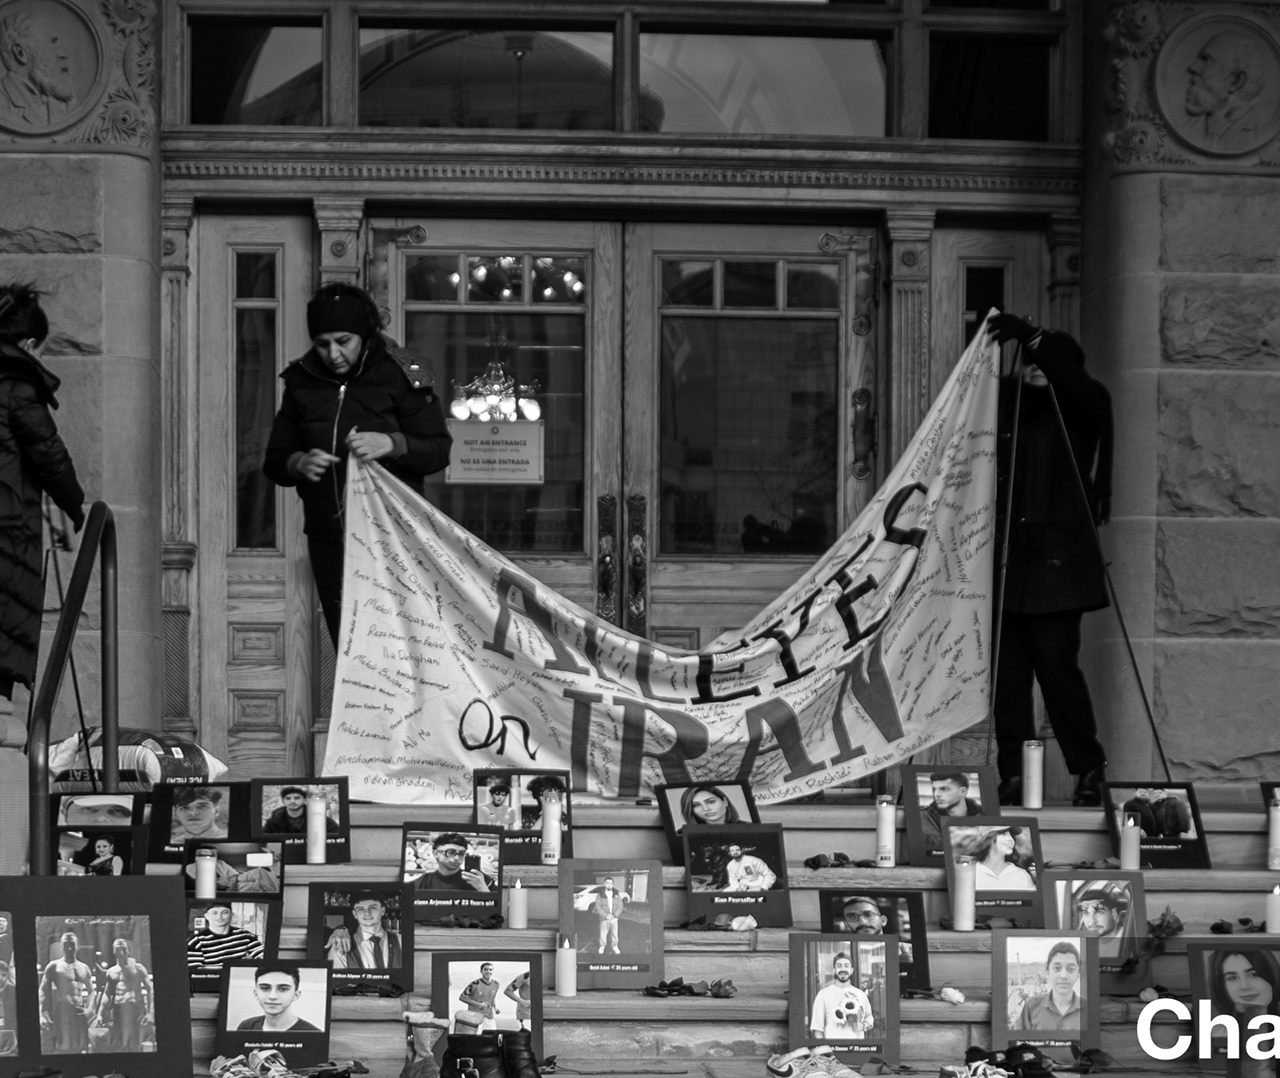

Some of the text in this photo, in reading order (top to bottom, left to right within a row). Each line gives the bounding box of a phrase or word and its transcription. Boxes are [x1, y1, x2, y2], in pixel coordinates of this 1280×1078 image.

[463, 439, 527, 447] NOT AN ENTRANCE
[460, 458, 531, 466] NO ES UNA ENTRADA
[458, 696, 539, 761] On
[563, 632, 905, 798] IRAN
